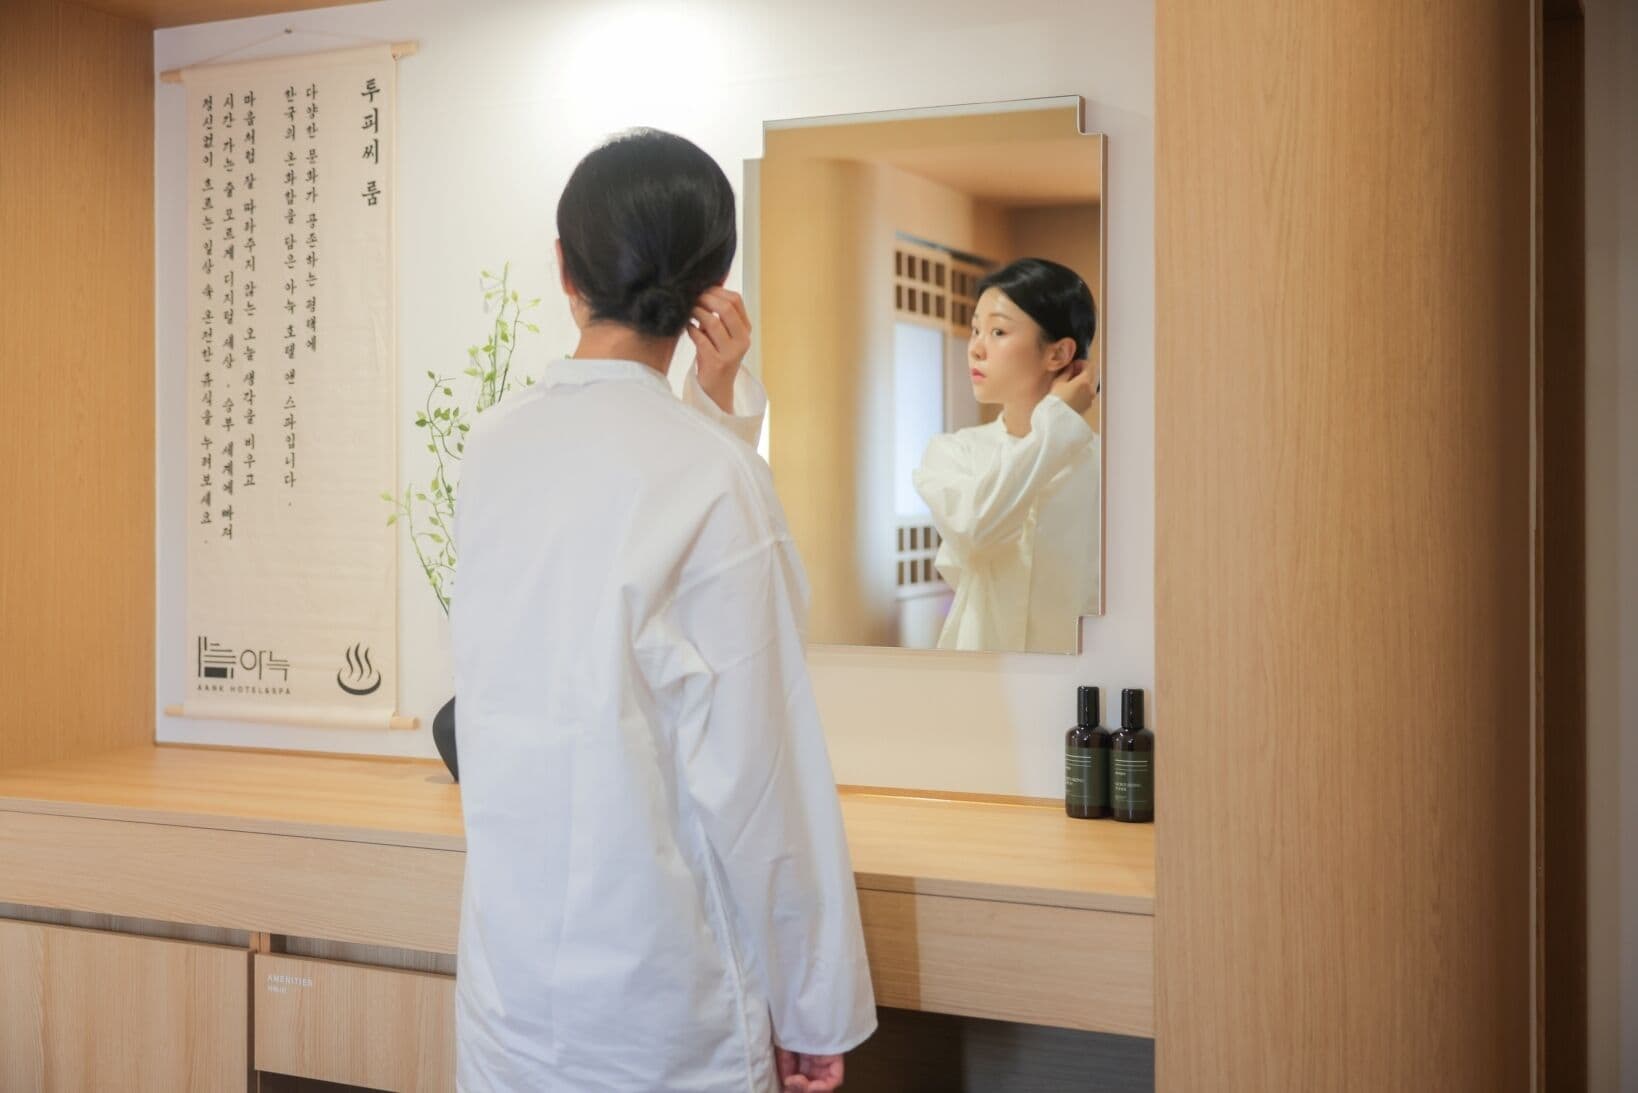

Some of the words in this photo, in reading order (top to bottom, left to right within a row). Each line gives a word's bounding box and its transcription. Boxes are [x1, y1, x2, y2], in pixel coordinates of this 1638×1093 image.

[202, 96, 213, 168] 정신없이
[223, 93, 234, 129] 시간
[243, 91, 255, 164] 마음처럼
[284, 87, 296, 141] 한국의
[305, 84, 318, 139] 다양한
[361, 78, 381, 165] 투피씨
[223, 138, 234, 172] 가는
[305, 149, 317, 203] 문화가
[202, 178, 213, 231] 흐르는
[223, 182, 234, 199] 줄
[244, 174, 255, 190] 잘
[284, 152, 296, 225] 온화함을
[361, 180, 382, 207] 룸
[202, 240, 213, 274] 일상
[223, 209, 234, 260] 모르게
[243, 199, 255, 272] 따라주지
[284, 234, 297, 269] 담은
[305, 214, 318, 287] 공존하는
[202, 284, 212, 299] 속
[223, 271, 233, 325] 디지털
[243, 281, 255, 316] 않는
[284, 279, 297, 315] 아늑
[202, 309, 213, 362] 온전한
[243, 328, 255, 361] 오늘
[283, 325, 296, 360] 호텔
[305, 297, 316, 352] 평택에
[201, 372, 212, 426] 휴식을
[222, 398, 234, 432] 승부
[243, 370, 255, 424] 생각을
[222, 442, 233, 495] 세계에
[243, 434, 255, 487] 비우고
[221, 505, 233, 540] 빠져
